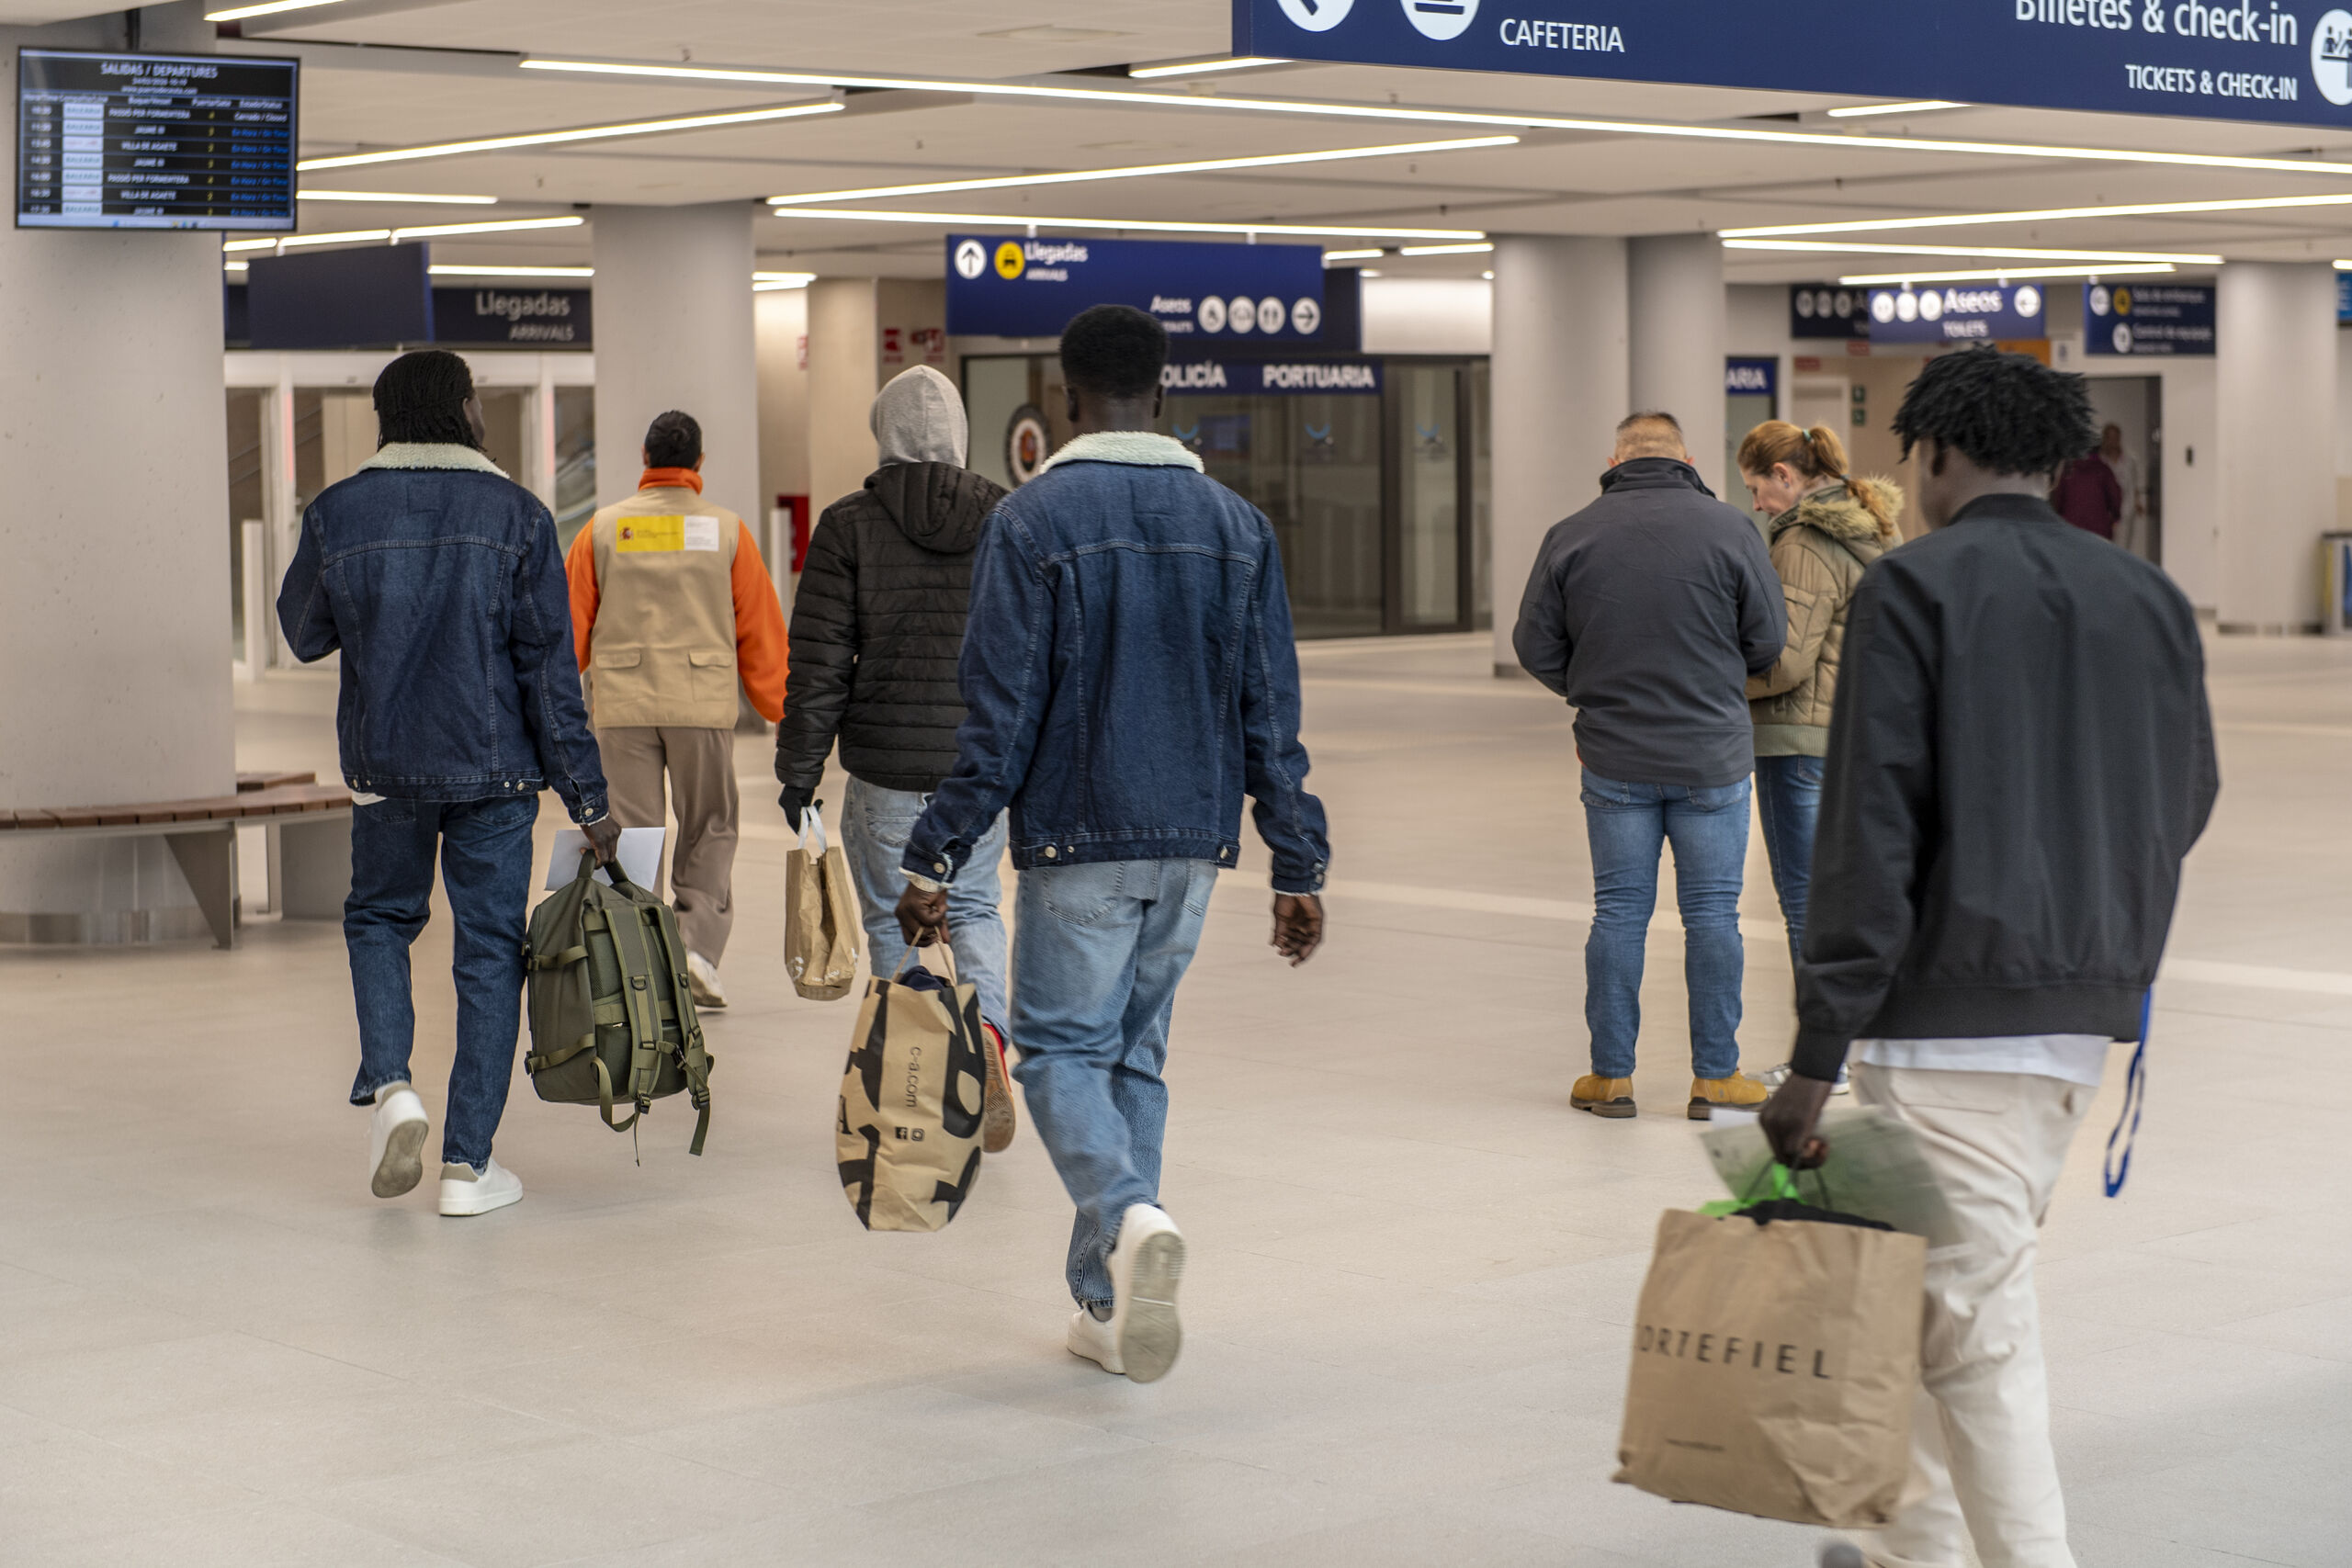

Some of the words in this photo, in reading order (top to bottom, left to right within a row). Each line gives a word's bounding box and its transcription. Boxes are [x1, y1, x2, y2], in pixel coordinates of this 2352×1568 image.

[1499, 18, 1625, 52] CAFETERIA
[2143, 0, 2166, 34] &
[2174, 0, 2297, 46] check-in
[101, 61, 143, 75] SALIDAS
[153, 63, 218, 78] DEPARTURES
[2125, 63, 2196, 94] TICKETS
[2199, 70, 2214, 95] &
[2217, 71, 2297, 101] CHECK-IN
[1024, 242, 1088, 265] Llegadas
[476, 291, 571, 321] Llegadas
[1150, 295, 1193, 314] Aseos
[1943, 288, 2003, 314] Aseos
[510, 324, 574, 341] ARRIVALS
[1942, 320, 1989, 338] TOILETS
[1159, 359, 1227, 388] OLICÍA
[1262, 365, 1375, 389] PORTUARIA
[906, 1046, 922, 1108] c-a.com
[1636, 1325, 1833, 1380] ORTEFIEL
